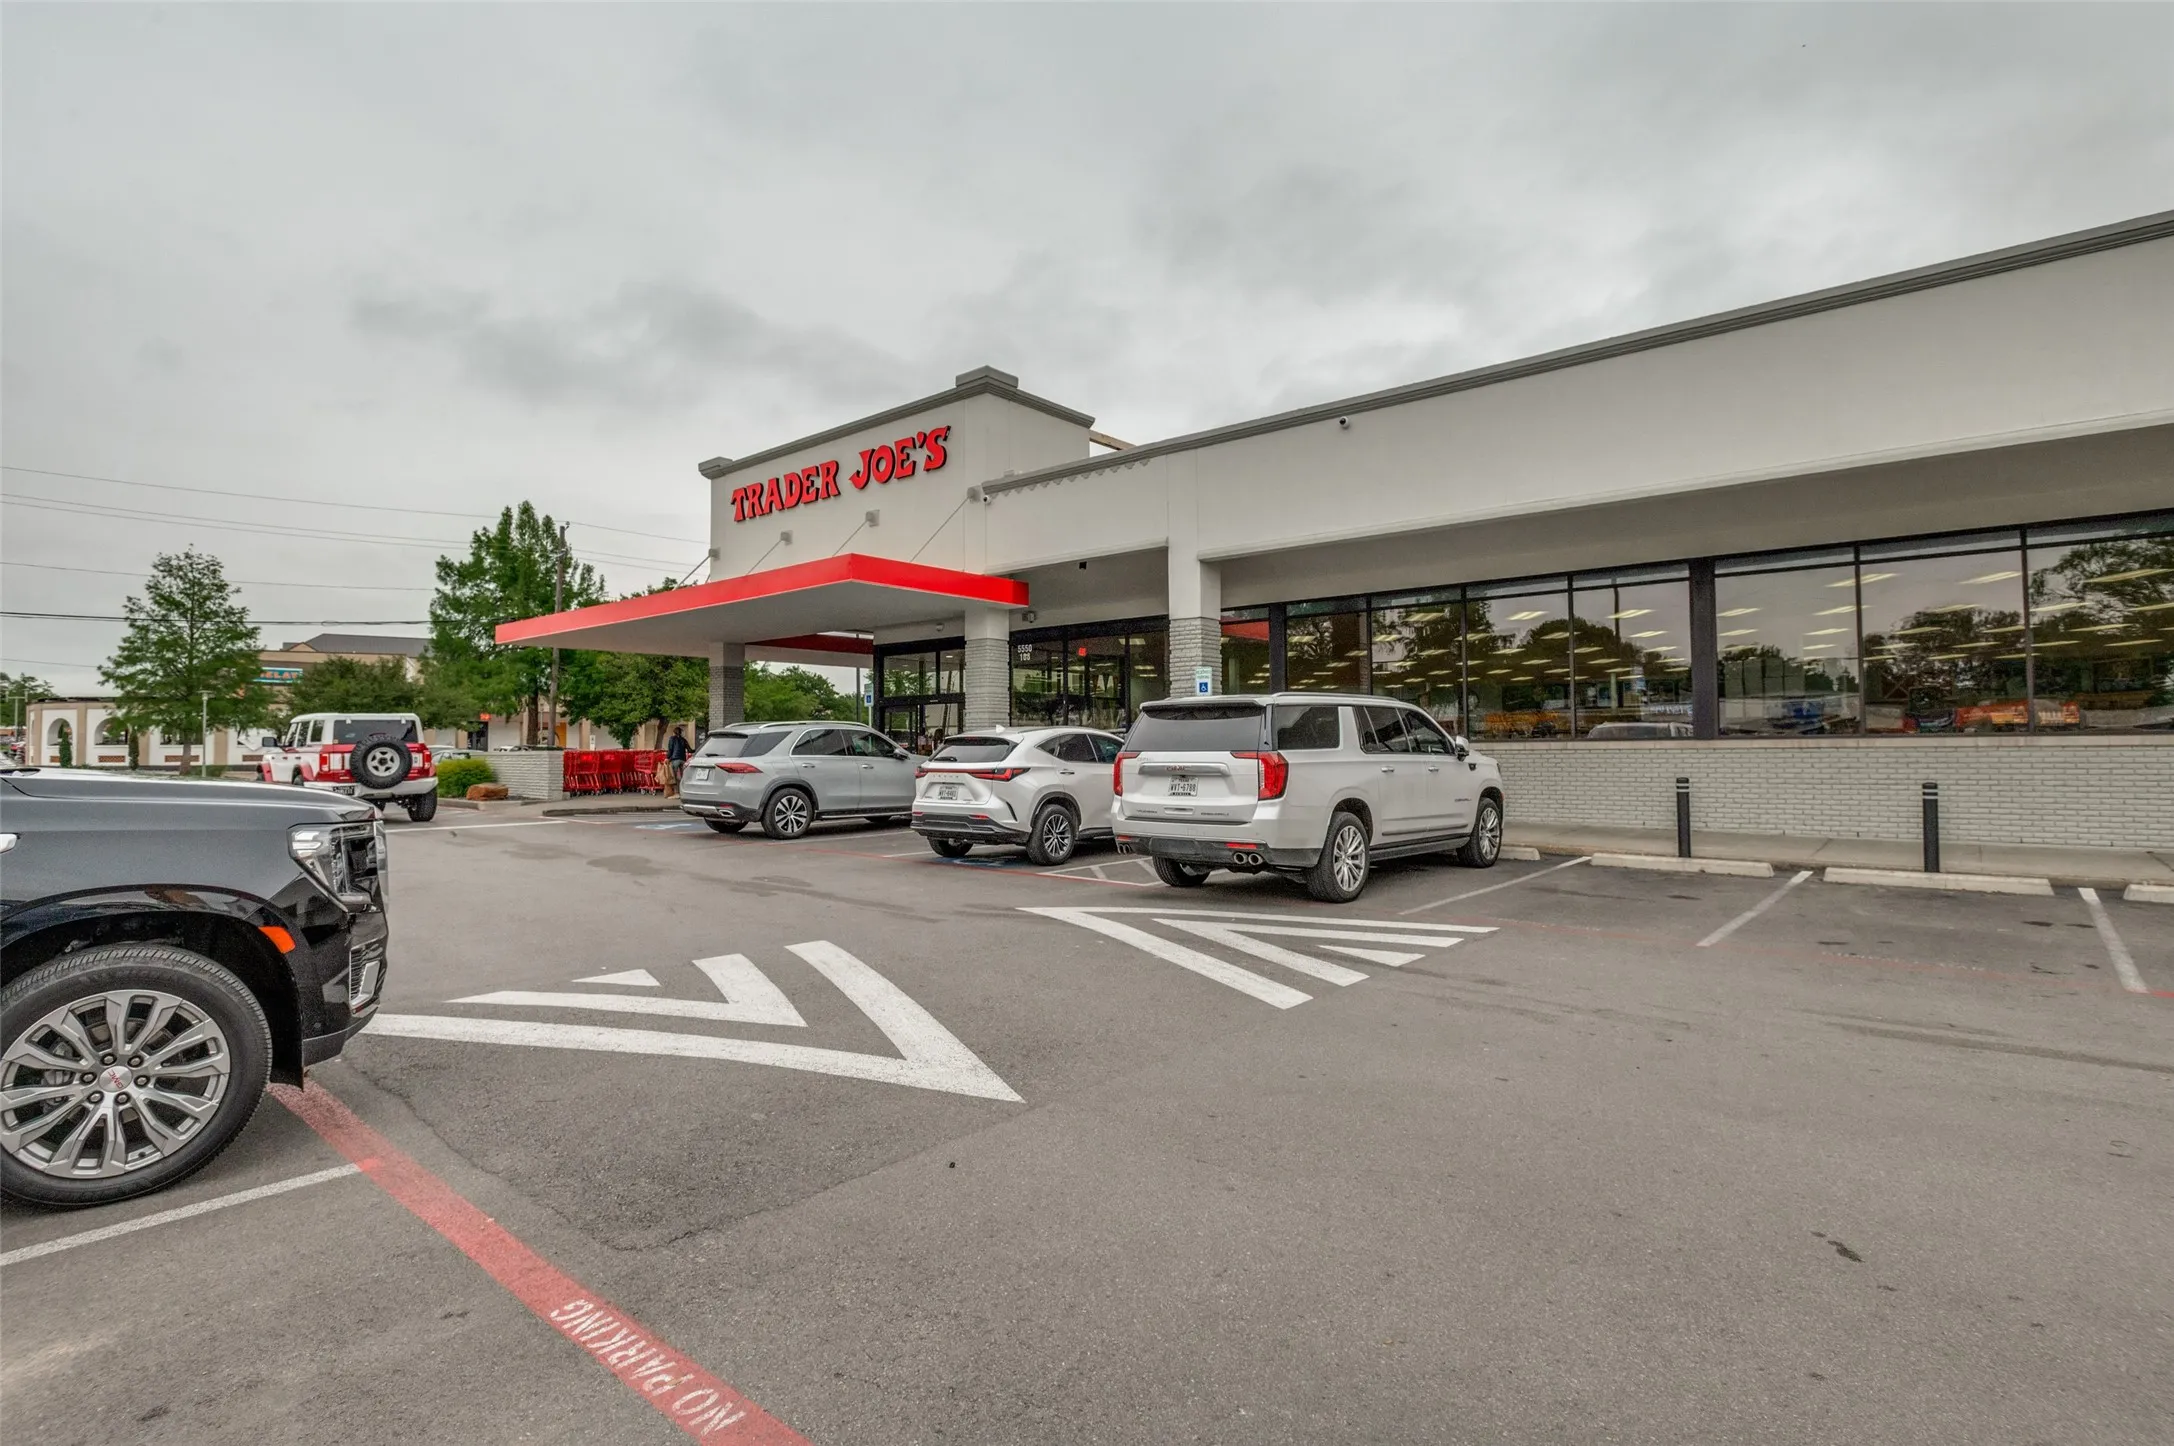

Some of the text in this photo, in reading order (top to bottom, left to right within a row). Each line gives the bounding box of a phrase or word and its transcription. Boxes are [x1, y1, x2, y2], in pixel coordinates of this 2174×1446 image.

[731, 425, 952, 522] TRADER JOE'S
[1017, 643, 1033, 654] 5550
[107, 1069, 124, 1088] GMC
[550, 1299, 746, 1437] NO PARKING
